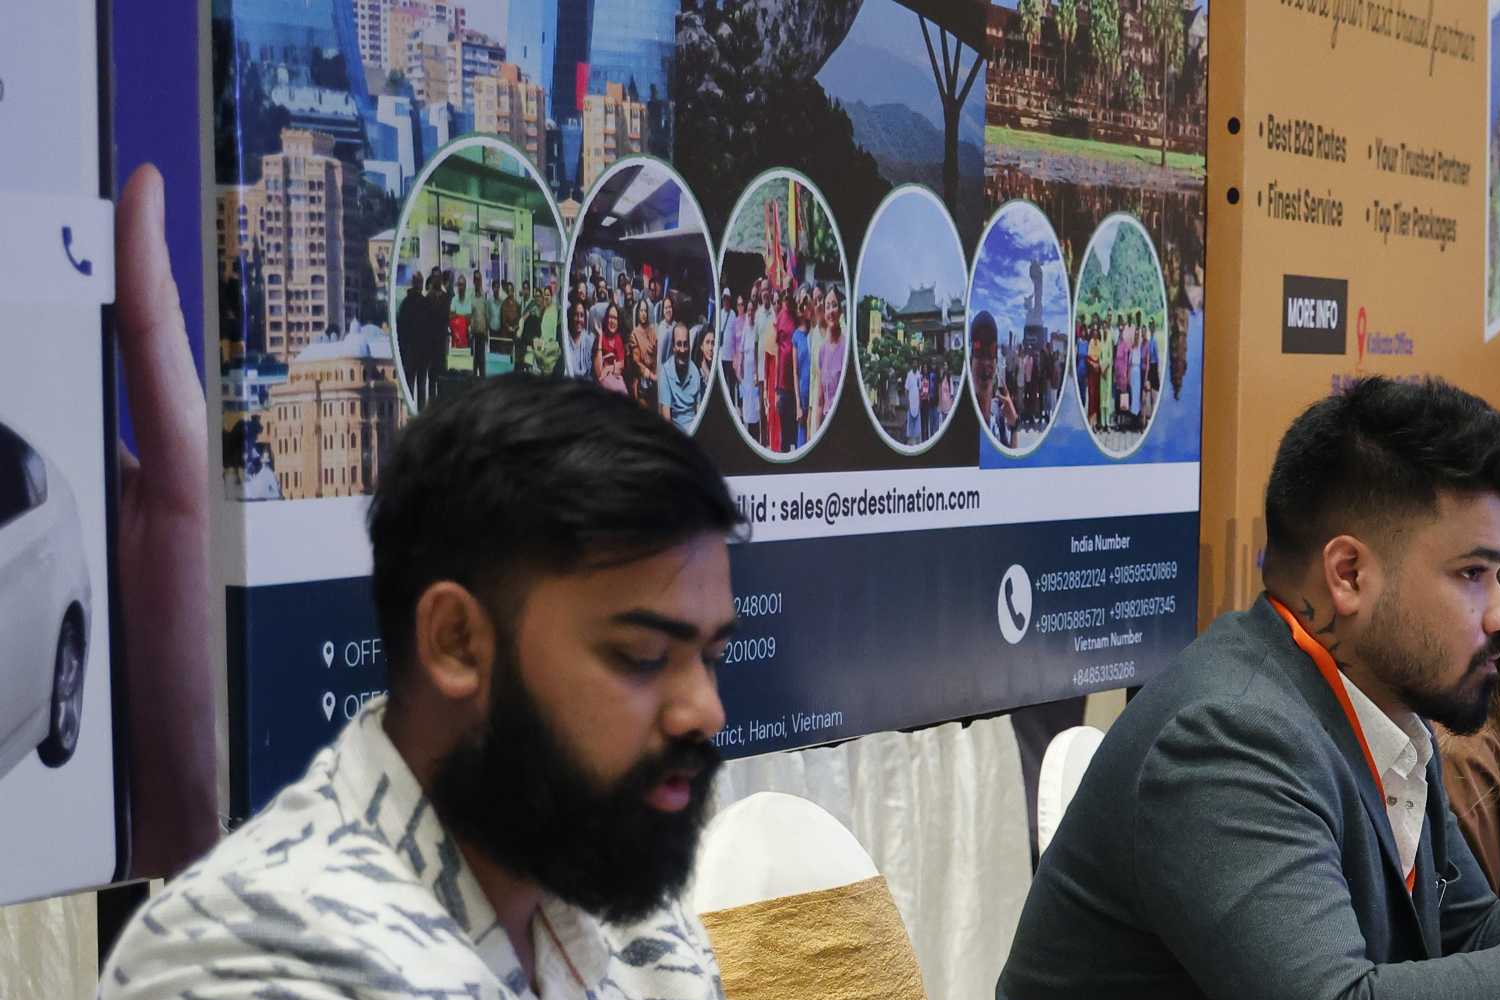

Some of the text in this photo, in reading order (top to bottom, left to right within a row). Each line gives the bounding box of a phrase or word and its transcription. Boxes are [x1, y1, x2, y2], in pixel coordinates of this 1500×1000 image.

[1267, 114, 1347, 163] Best B2B Rates
[1375, 137, 1471, 187] Your Trusted Partner
[1267, 179, 1344, 227] Finest Service
[1374, 200, 1457, 252] Top Tier Packages
[1287, 297, 1338, 330] MORE INFO
[750, 493, 767, 523] id
[780, 485, 981, 525] sales@srdestination.com
[1070, 533, 1131, 553] India Number
[1074, 628, 1143, 652] Vietnam Number
[712, 710, 843, 747] trict, Hanoi, Vietnam
